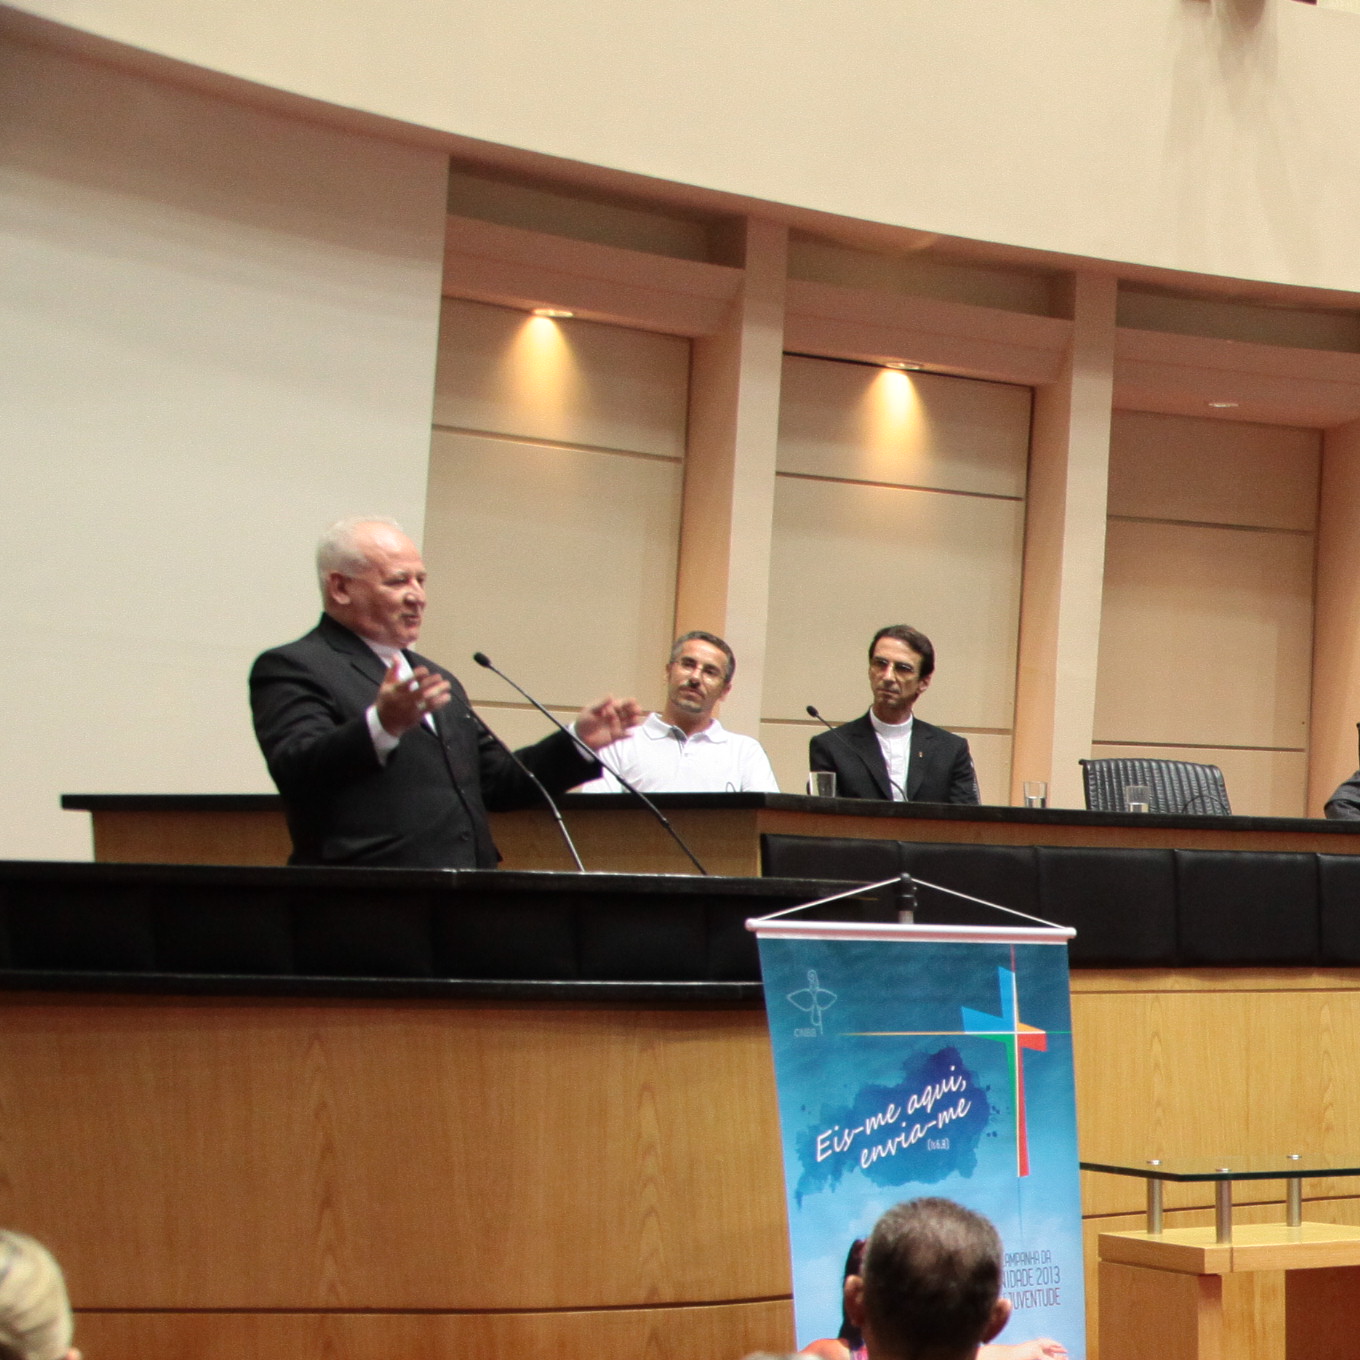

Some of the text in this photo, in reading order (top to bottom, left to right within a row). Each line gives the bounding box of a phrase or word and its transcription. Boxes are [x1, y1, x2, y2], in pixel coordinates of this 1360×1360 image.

[816, 1103, 901, 1162] Eis-me
[860, 1098, 972, 1169] envia-me
[1001, 1265, 1061, 1289] NIDADE 2013
[1004, 1249, 1052, 1267] AMPANHA DA
